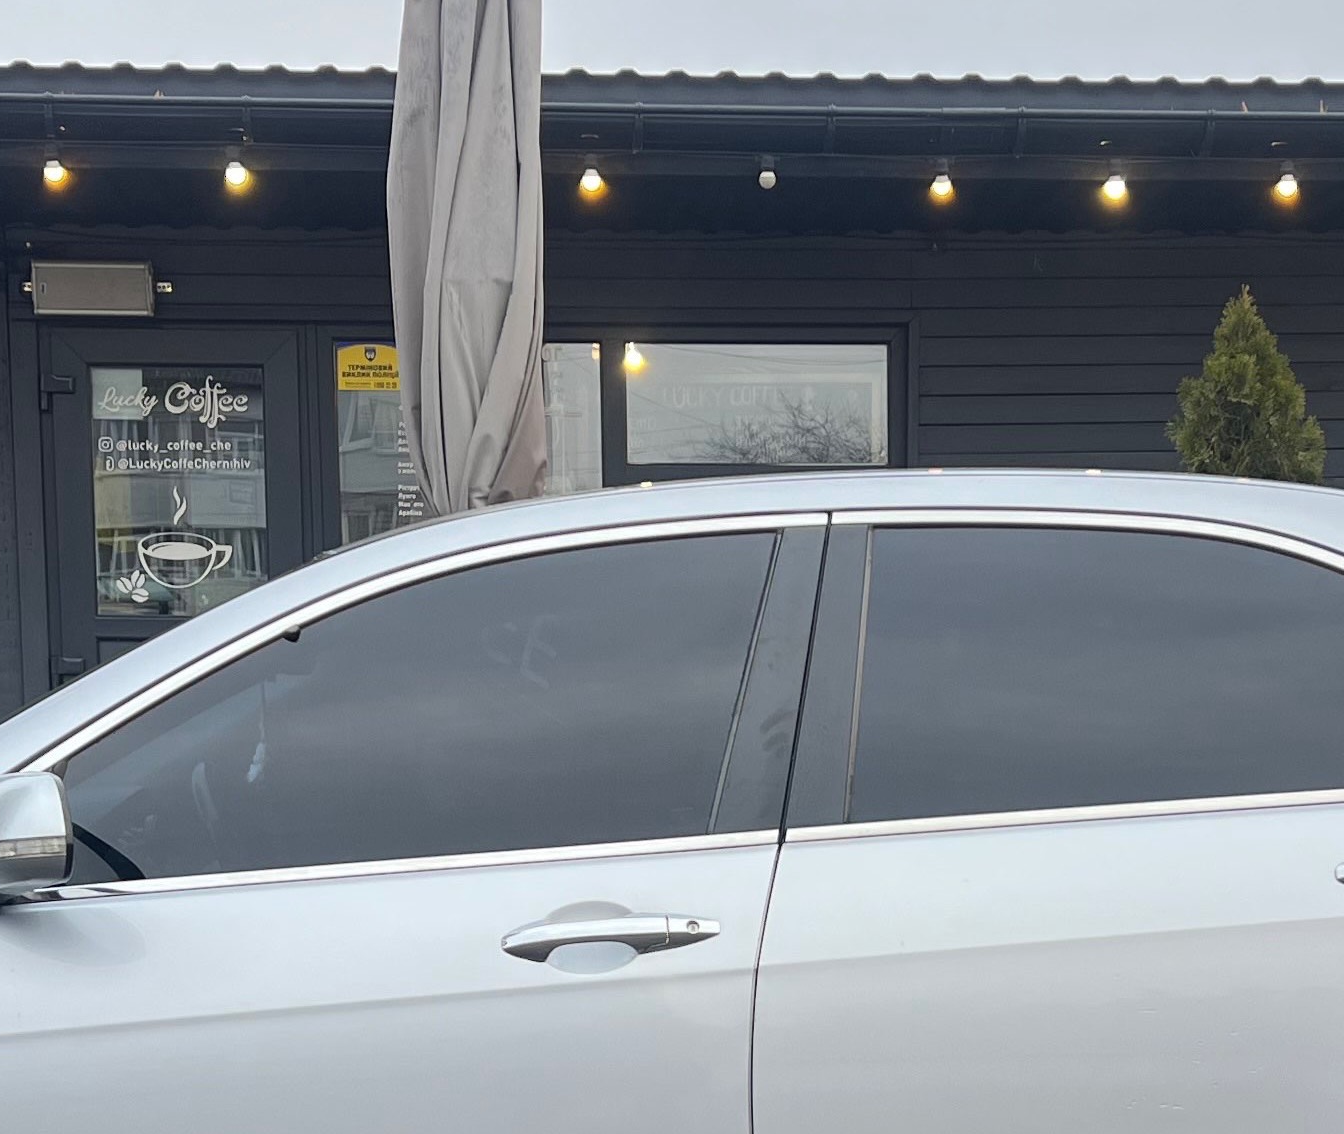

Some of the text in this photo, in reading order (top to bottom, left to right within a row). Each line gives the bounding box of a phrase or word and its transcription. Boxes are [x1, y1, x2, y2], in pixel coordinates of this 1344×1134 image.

[98, 375, 249, 428] Lucky Coffee
[116, 440, 232, 453] @lucky_coffee_che
